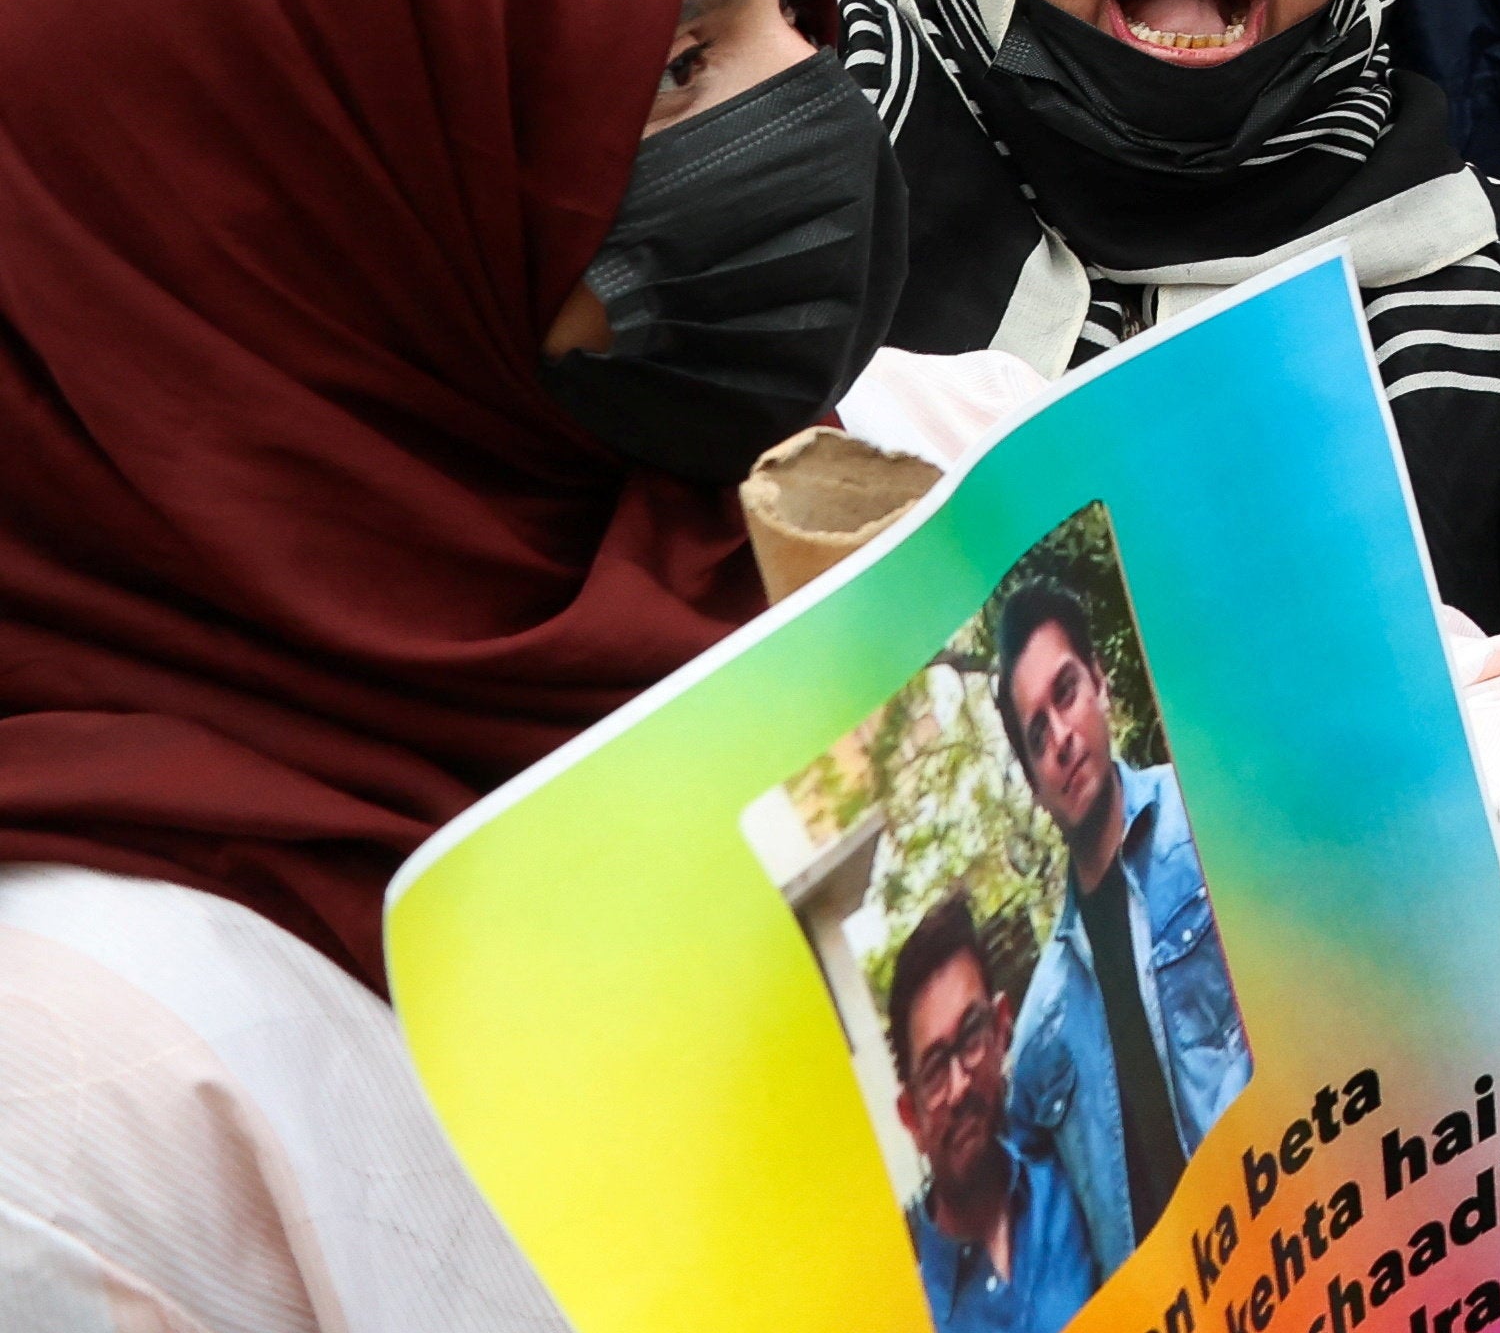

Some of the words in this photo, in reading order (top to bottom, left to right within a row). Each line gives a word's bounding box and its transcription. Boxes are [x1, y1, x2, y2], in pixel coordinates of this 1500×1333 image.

[1191, 1203, 1241, 1306] ka
[1241, 1067, 1384, 1222] beta
[1225, 1180, 1364, 1333] kehta
[1381, 1073, 1499, 1200] hai
